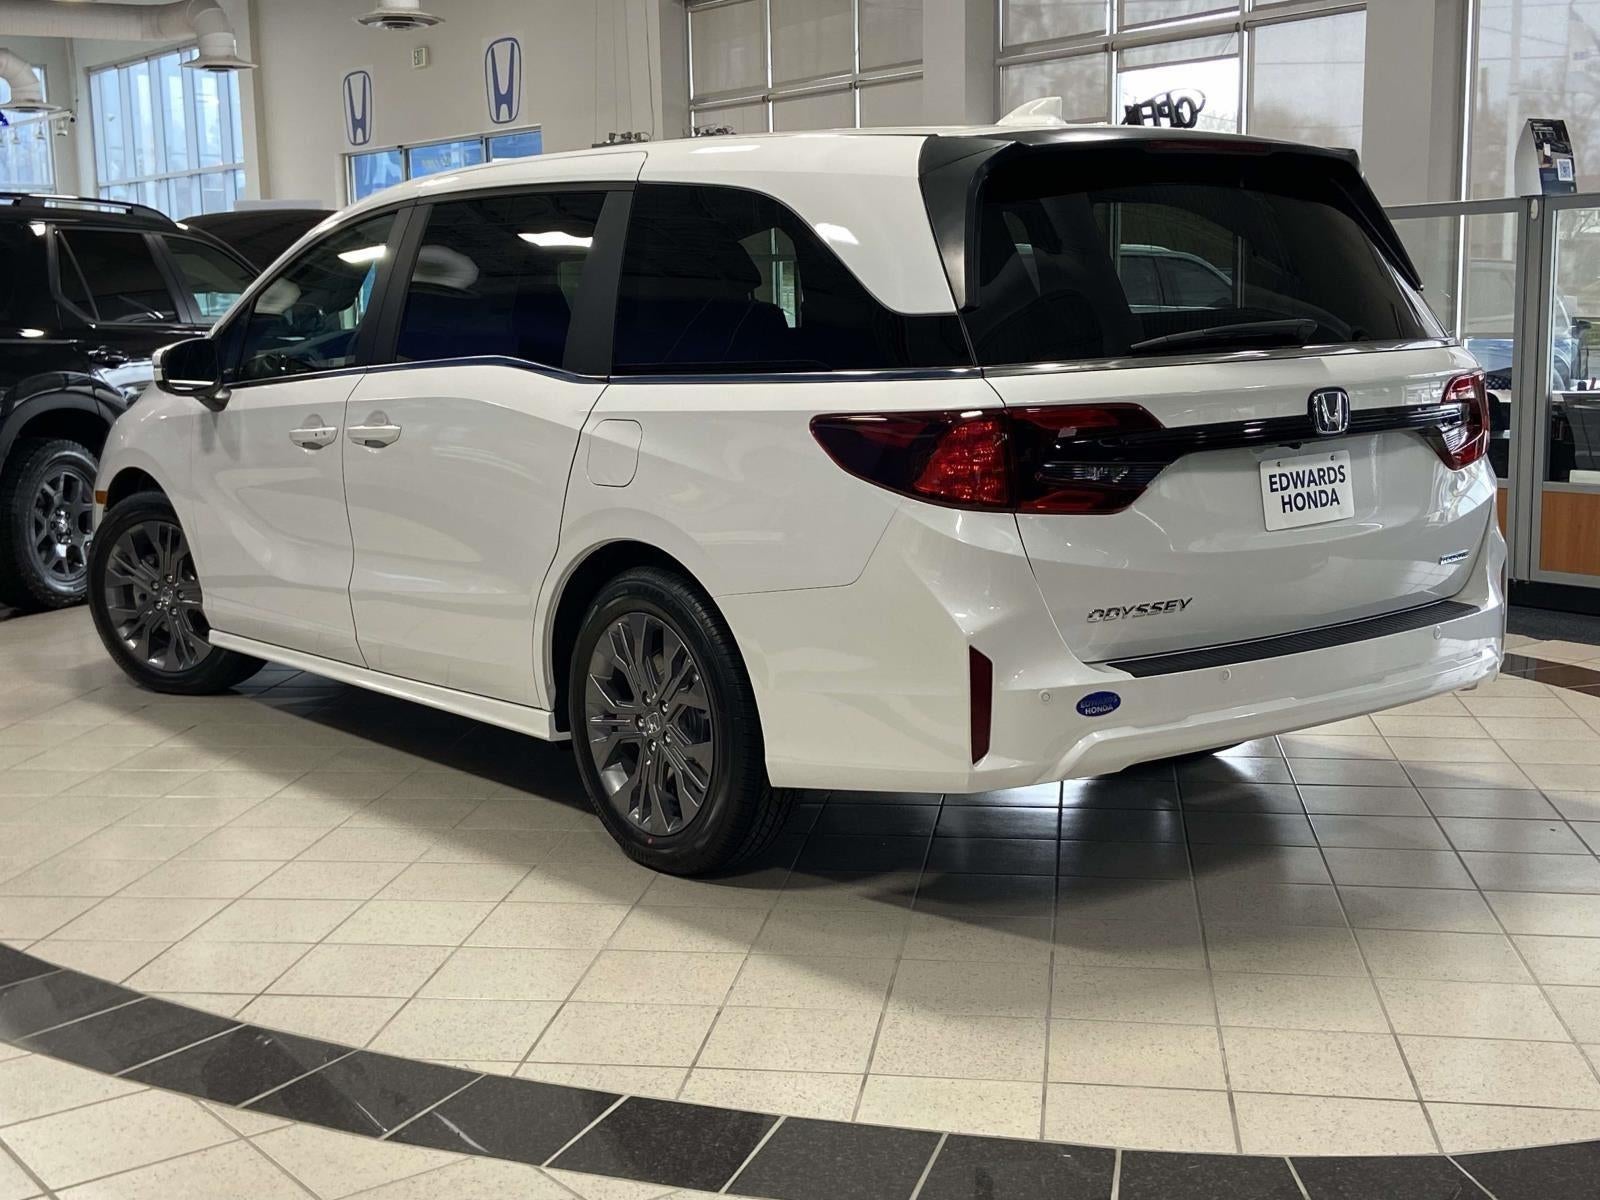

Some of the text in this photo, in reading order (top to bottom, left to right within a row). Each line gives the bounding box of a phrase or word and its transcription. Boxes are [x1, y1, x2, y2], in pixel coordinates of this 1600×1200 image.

[1268, 464, 1346, 493] EDWARDS
[1280, 487, 1341, 514] HONDA
[1087, 597, 1193, 623] ODYSSEY
[1085, 703, 1114, 715] HONDA
